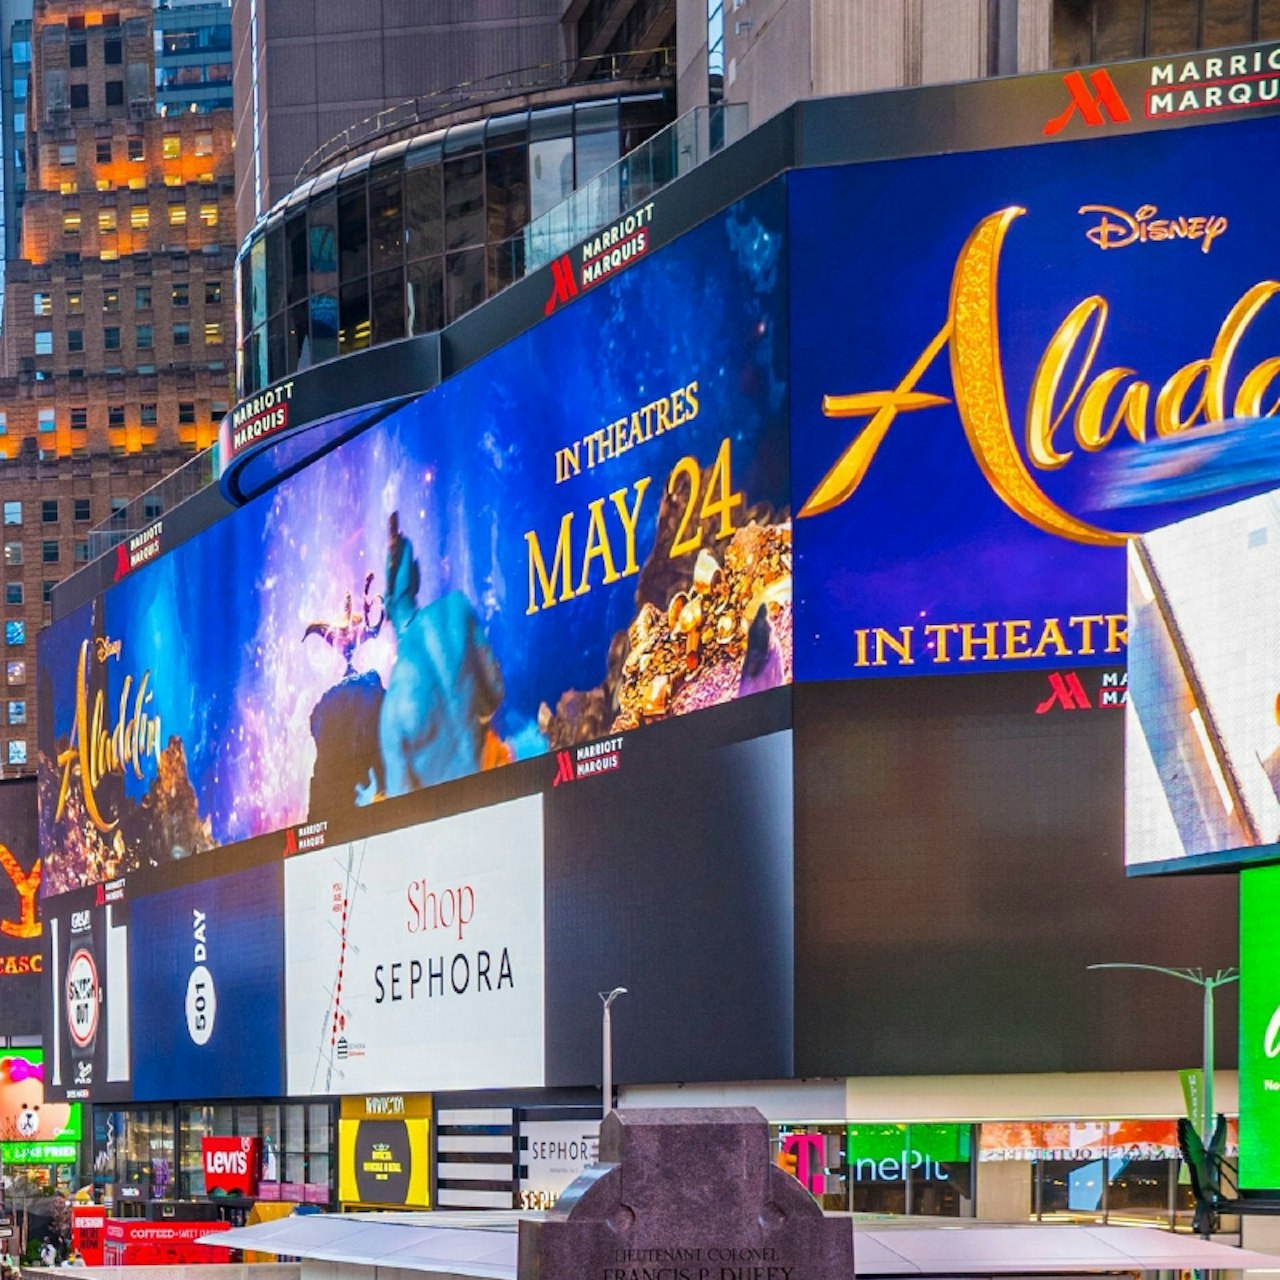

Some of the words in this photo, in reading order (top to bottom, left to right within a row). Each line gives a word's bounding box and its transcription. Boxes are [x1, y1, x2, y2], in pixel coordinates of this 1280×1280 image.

[582, 203, 654, 261] MARRIOTT
[582, 232, 647, 286] MARQUIS
[232, 382, 293, 428] MARRIOTT
[233, 407, 287, 450] MARQUIS
[555, 444, 580, 483] IN
[583, 382, 700, 470] THEATRES
[525, 476, 653, 616] MAY
[669, 437, 742, 558] 24
[855, 626, 914, 667] IN
[57, 637, 162, 832] Aladdin
[576, 737, 623, 761] MARRIOTT
[576, 754, 620, 778] MARQUIS
[407, 878, 475, 940] Shop
[192, 908, 208, 963] DAY
[374, 947, 515, 1004] SEPHORA
[192, 980, 210, 1031] 501
[75, 1217, 104, 1228] DESIGN
[615, 1249, 700, 1262] LIEUTENANT
[708, 1248, 779, 1261] COLONEL
